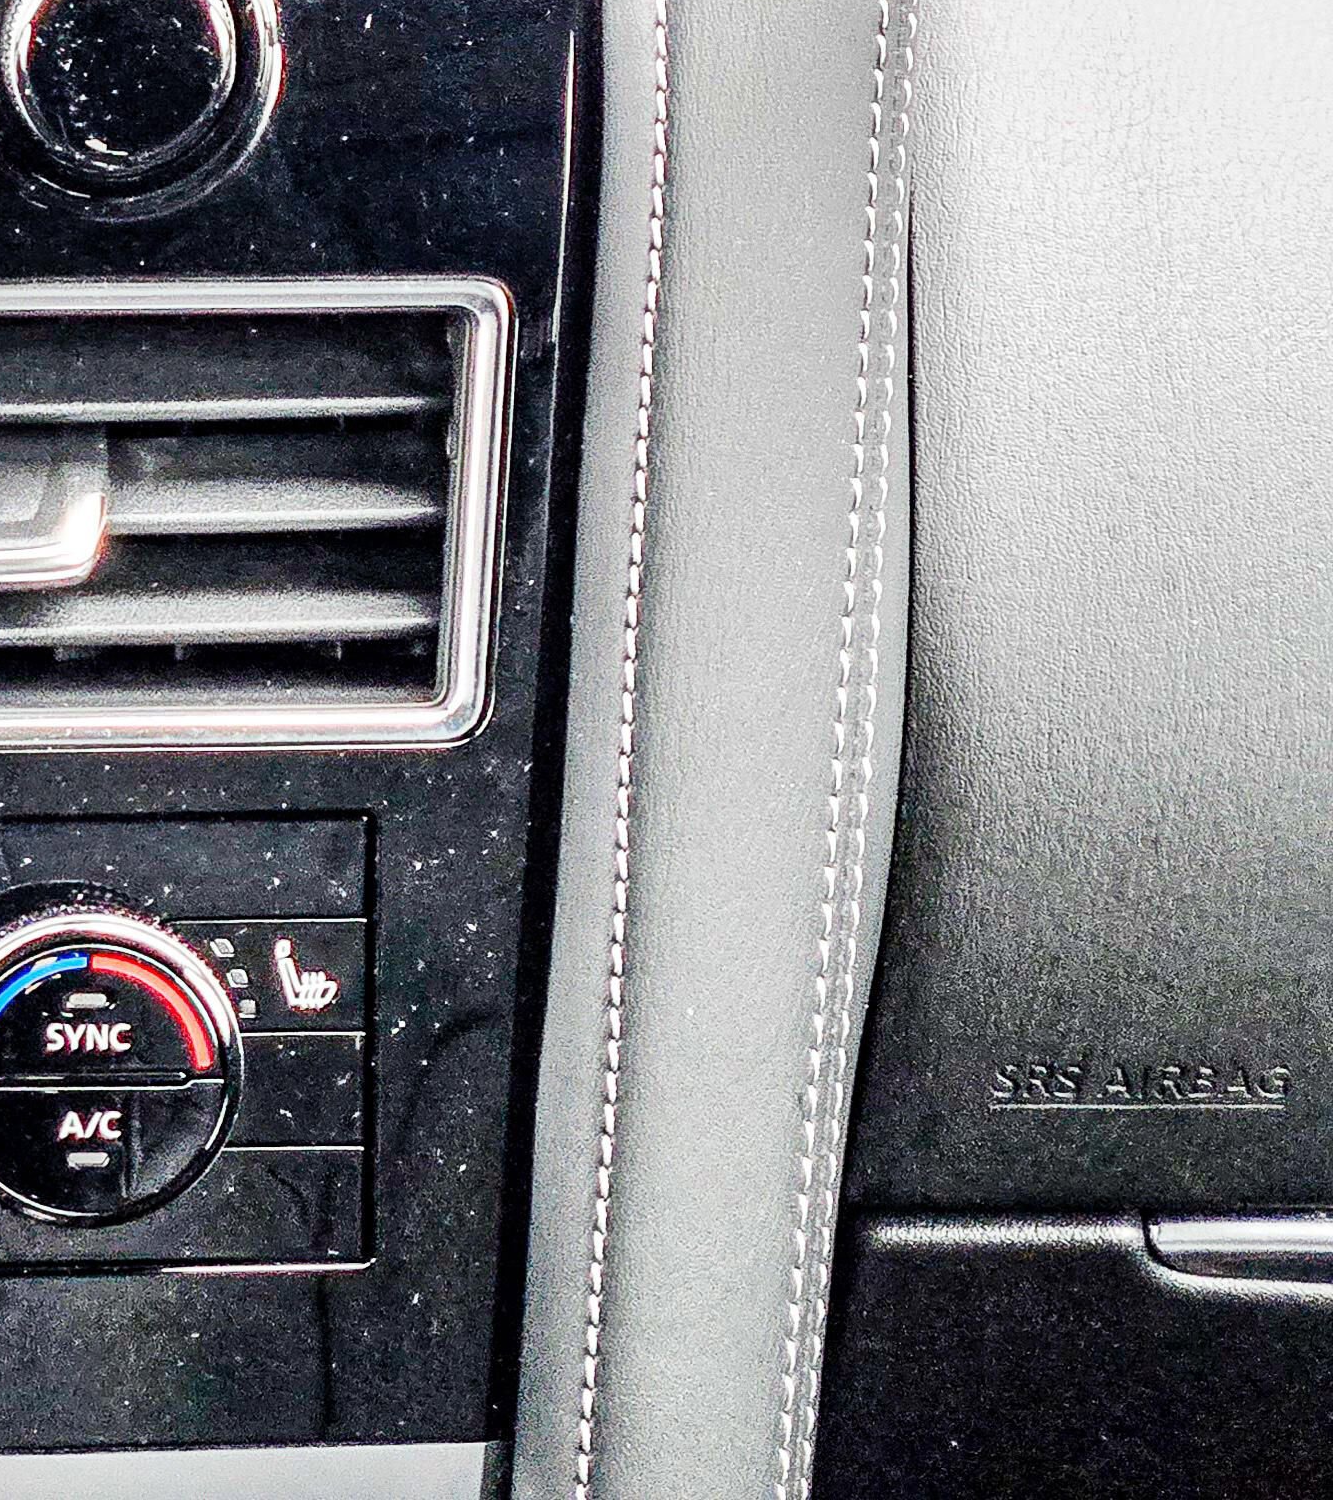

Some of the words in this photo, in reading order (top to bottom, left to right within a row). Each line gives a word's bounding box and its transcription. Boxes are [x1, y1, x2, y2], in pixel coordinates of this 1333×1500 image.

[46, 1023, 131, 1052] SYNC
[992, 1065, 1082, 1098] SRS
[1097, 1065, 1290, 1100] AIRBAG
[58, 1110, 122, 1141] A/C
